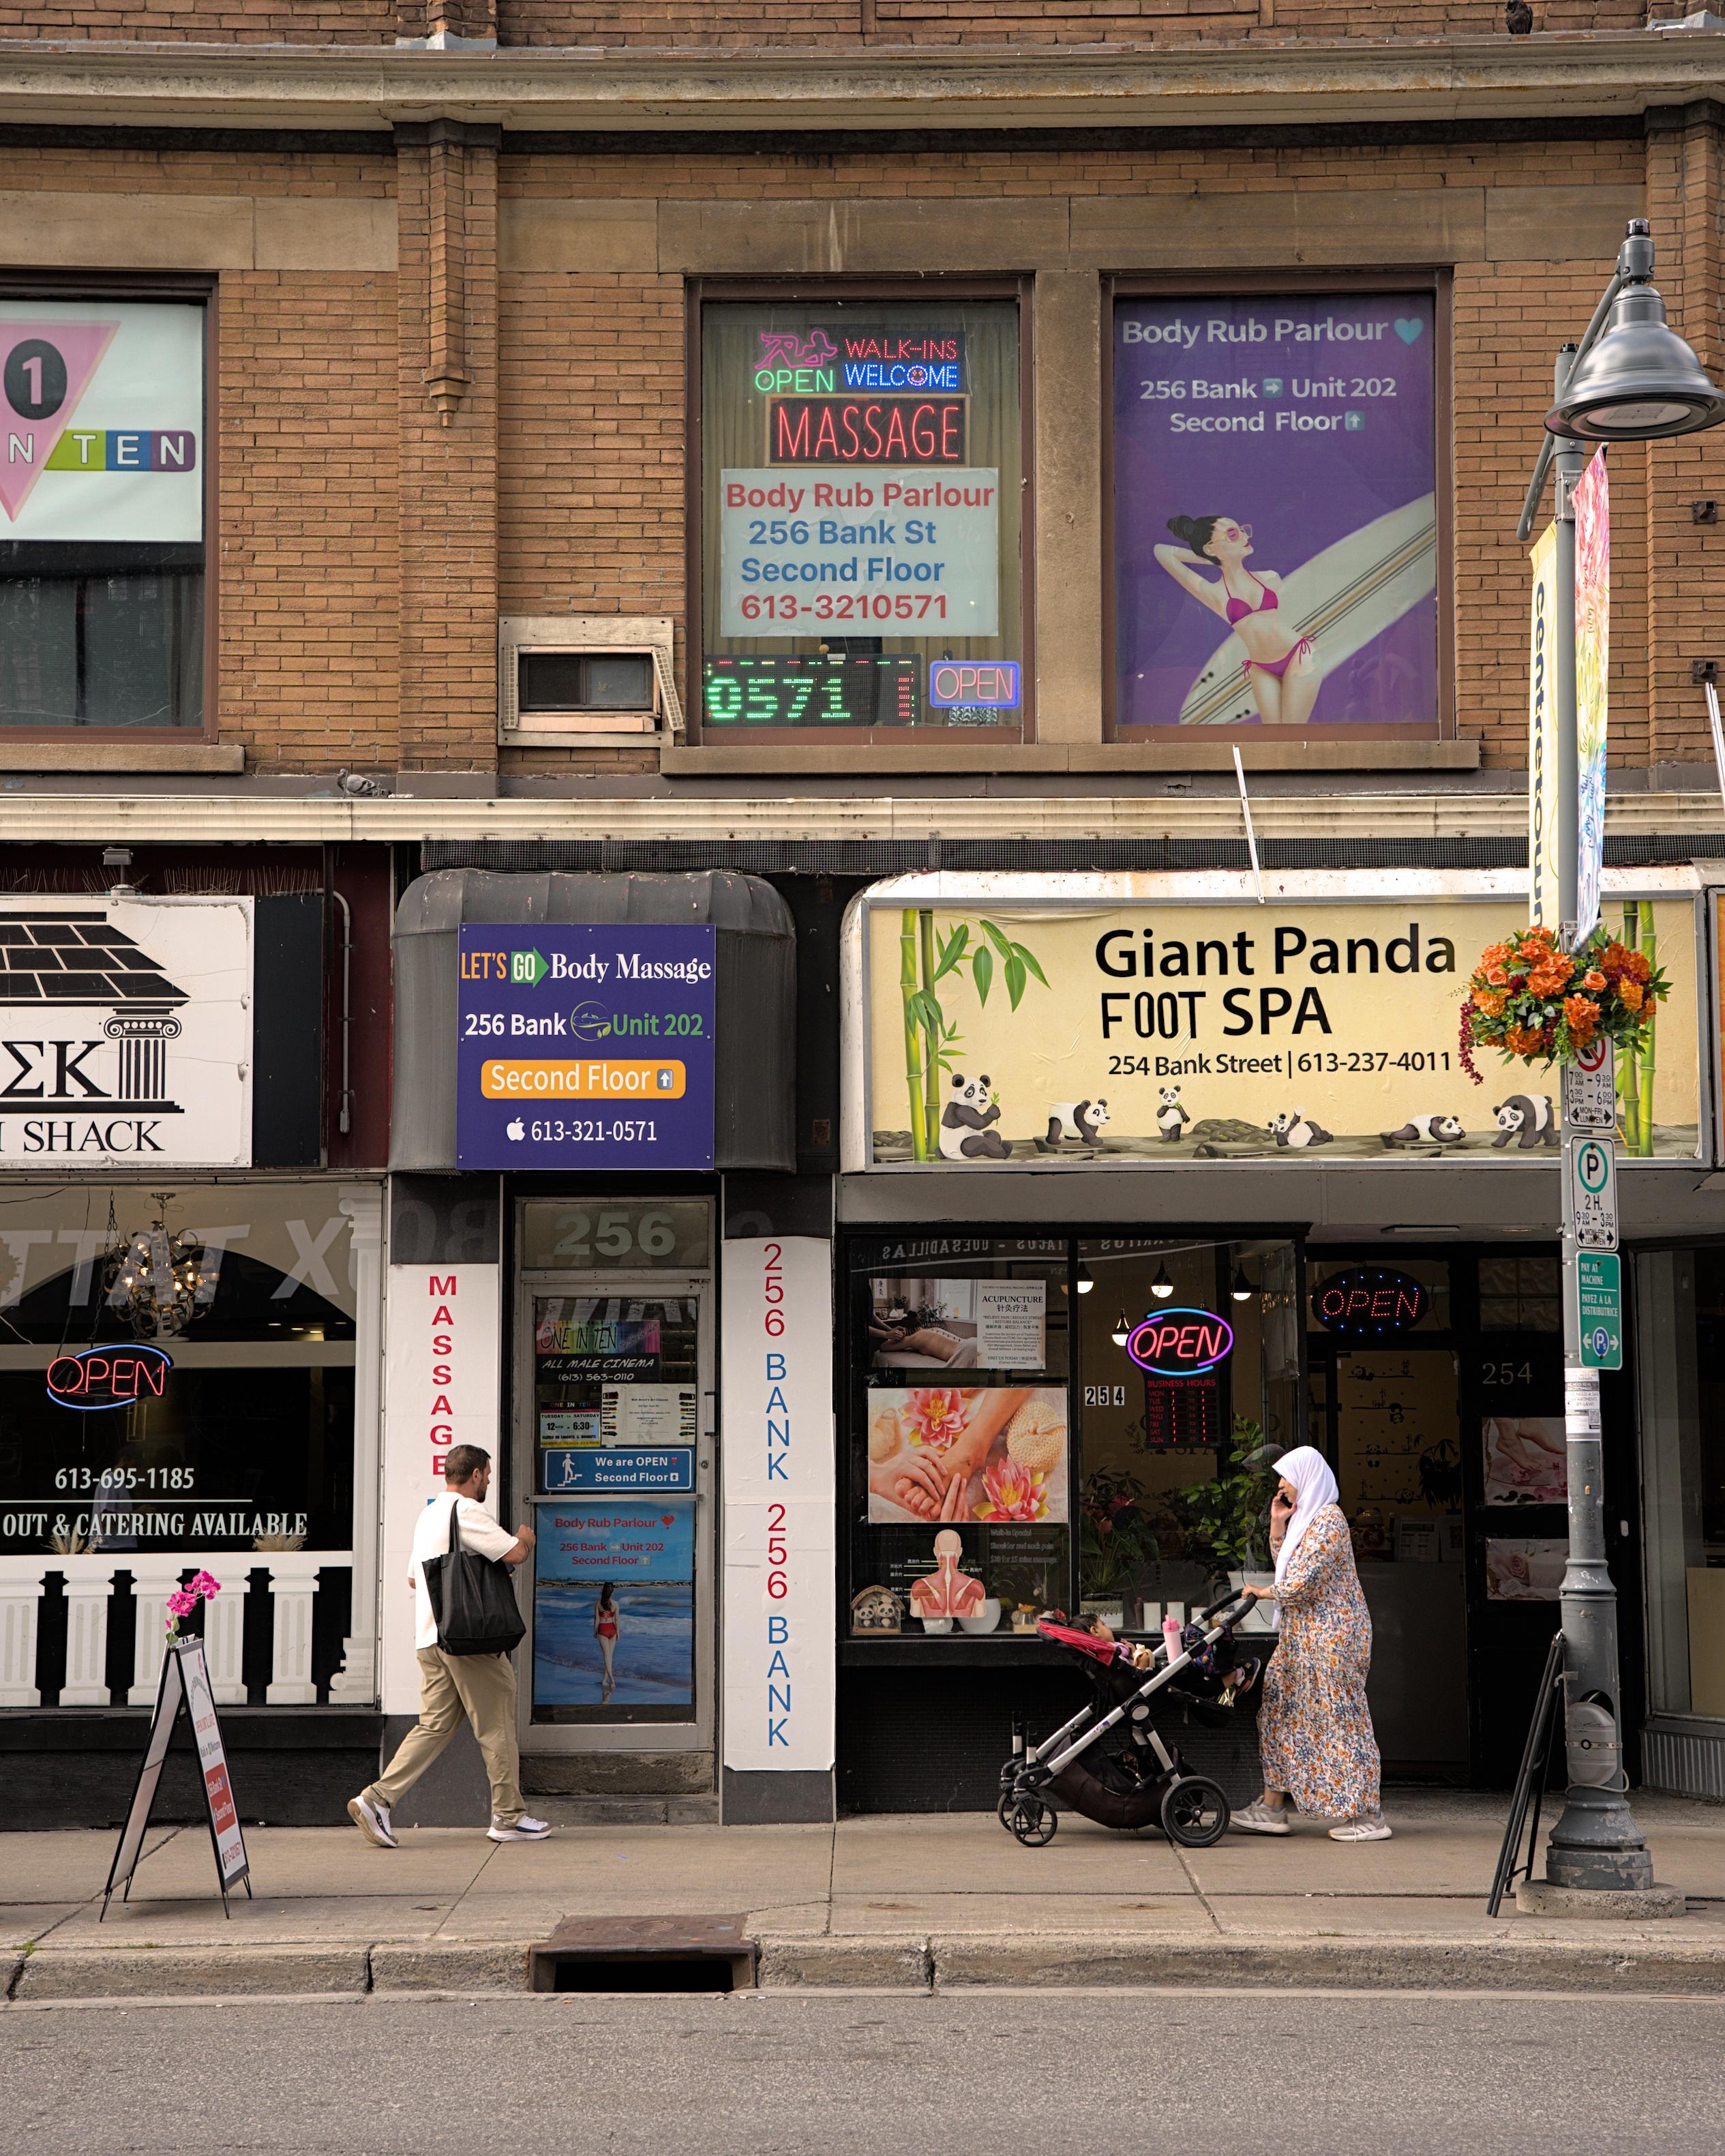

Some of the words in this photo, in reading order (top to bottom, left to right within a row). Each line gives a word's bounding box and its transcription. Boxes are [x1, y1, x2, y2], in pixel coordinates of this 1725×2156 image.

[1122, 319, 1201, 349] Body
[1207, 318, 1268, 343] Rub
[1275, 317, 1389, 341] Parlour
[845, 339, 957, 359] WALK-INS
[22, 356, 42, 405] 1
[755, 370, 833, 392] OPEN
[845, 363, 957, 387] WELCOME
[1139, 380, 1186, 400] 256
[1192, 378, 1258, 399] Bank
[1292, 377, 1347, 398] Unit
[1350, 377, 1396, 398] 202
[779, 405, 959, 458] MASSAGE
[1169, 412, 1264, 432] Second
[1276, 411, 1342, 431] Floor
[72, 434, 185, 465] TEN
[727, 483, 805, 513] Body
[815, 483, 874, 507] Rub
[884, 482, 995, 507] Parlour
[749, 520, 809, 545] 256
[819, 520, 896, 545] Bank
[905, 520, 937, 544] St
[741, 557, 857, 582] Second
[868, 557, 946, 582] Floor
[741, 595, 947, 619] 613-3210571
[935, 668, 1013, 700] OPEN
[708, 678, 851, 719] 0571
[1095, 928, 1255, 978] Giant
[1274, 923, 1456, 974] Panda
[461, 952, 507, 979] LET'S
[513, 953, 535, 980] GO
[550, 953, 610, 983] Body
[616, 953, 711, 984] Massage
[465, 1013, 505, 1036] 256
[511, 1013, 567, 1036] Bank
[612, 1013, 659, 1036] Unit
[665, 1013, 703, 1036] 202
[1100, 991, 1206, 1039] FOOT
[1222, 987, 1333, 1036] SPA
[1109, 1055, 1150, 1076] 254
[1155, 1053, 1212, 1076] Bank
[1216, 1053, 1282, 1073] Street
[1298, 1051, 1450, 1072] 613-237-4011
[490, 1063, 580, 1091] Second
[588, 1063, 651, 1091] Floor
[23, 1120, 166, 1152] SHACK
[531, 1120, 657, 1141] 613-321-0571
[1587, 1153, 1599, 1180] P
[1585, 1194, 1591, 1210] 2
[553, 1211, 676, 1257] 256
[1580, 1262, 1590, 1272] PAY
[764, 1243, 785, 1336] 256
[1581, 1274, 1603, 1285] MACHINE
[1322, 1289, 1419, 1317] OPEN
[1582, 1294, 1597, 1304] PAYEZ
[1604, 1296, 1612, 1304] LA
[1582, 1306, 1618, 1317] DISTRIBUTRICE
[541, 1326, 572, 1350] ONE
[577, 1326, 588, 1349] IN
[594, 1326, 616, 1350] TEN
[1133, 1326, 1223, 1358] OPEN
[541, 1359, 563, 1369] ALL
[567, 1358, 602, 1369] MALE
[602, 1358, 655, 1369] CINEMA
[1482, 1362, 1533, 1385] 254
[47, 1356, 165, 1396] OPEN
[429, 1276, 456, 1476] MASSAGE
[558, 1373, 582, 1382] (613)
[586, 1373, 635, 1381] 563-0110
[1147, 1379, 1184, 1388] BUSINESS
[1186, 1379, 1216, 1387] HOURS
[1086, 1387, 1124, 1403] 254
[573, 1422, 590, 1431] 6:30
[766, 1353, 790, 1480] BANK
[595, 1456, 613, 1466] We
[635, 1456, 668, 1466] OPEN
[55, 1467, 194, 1489] 613-695-1185
[595, 1472, 637, 1482] Second
[639, 1473, 668, 1482] Floor
[3, 1513, 48, 1537] OUT
[52, 1515, 70, 1537] &
[76, 1513, 185, 1536] CATERING
[190, 1512, 308, 1536] AVAILABLE
[555, 1518, 585, 1529] Body
[588, 1518, 611, 1528] Rub
[614, 1517, 657, 1527] Parlour
[581, 1543, 607, 1551] Bank
[621, 1542, 644, 1551] Unit
[645, 1543, 664, 1551] 202
[768, 1503, 787, 1599] 256
[572, 1556, 610, 1565] Second
[612, 1555, 639, 1565] Floor
[767, 1616, 791, 1747] BANK
